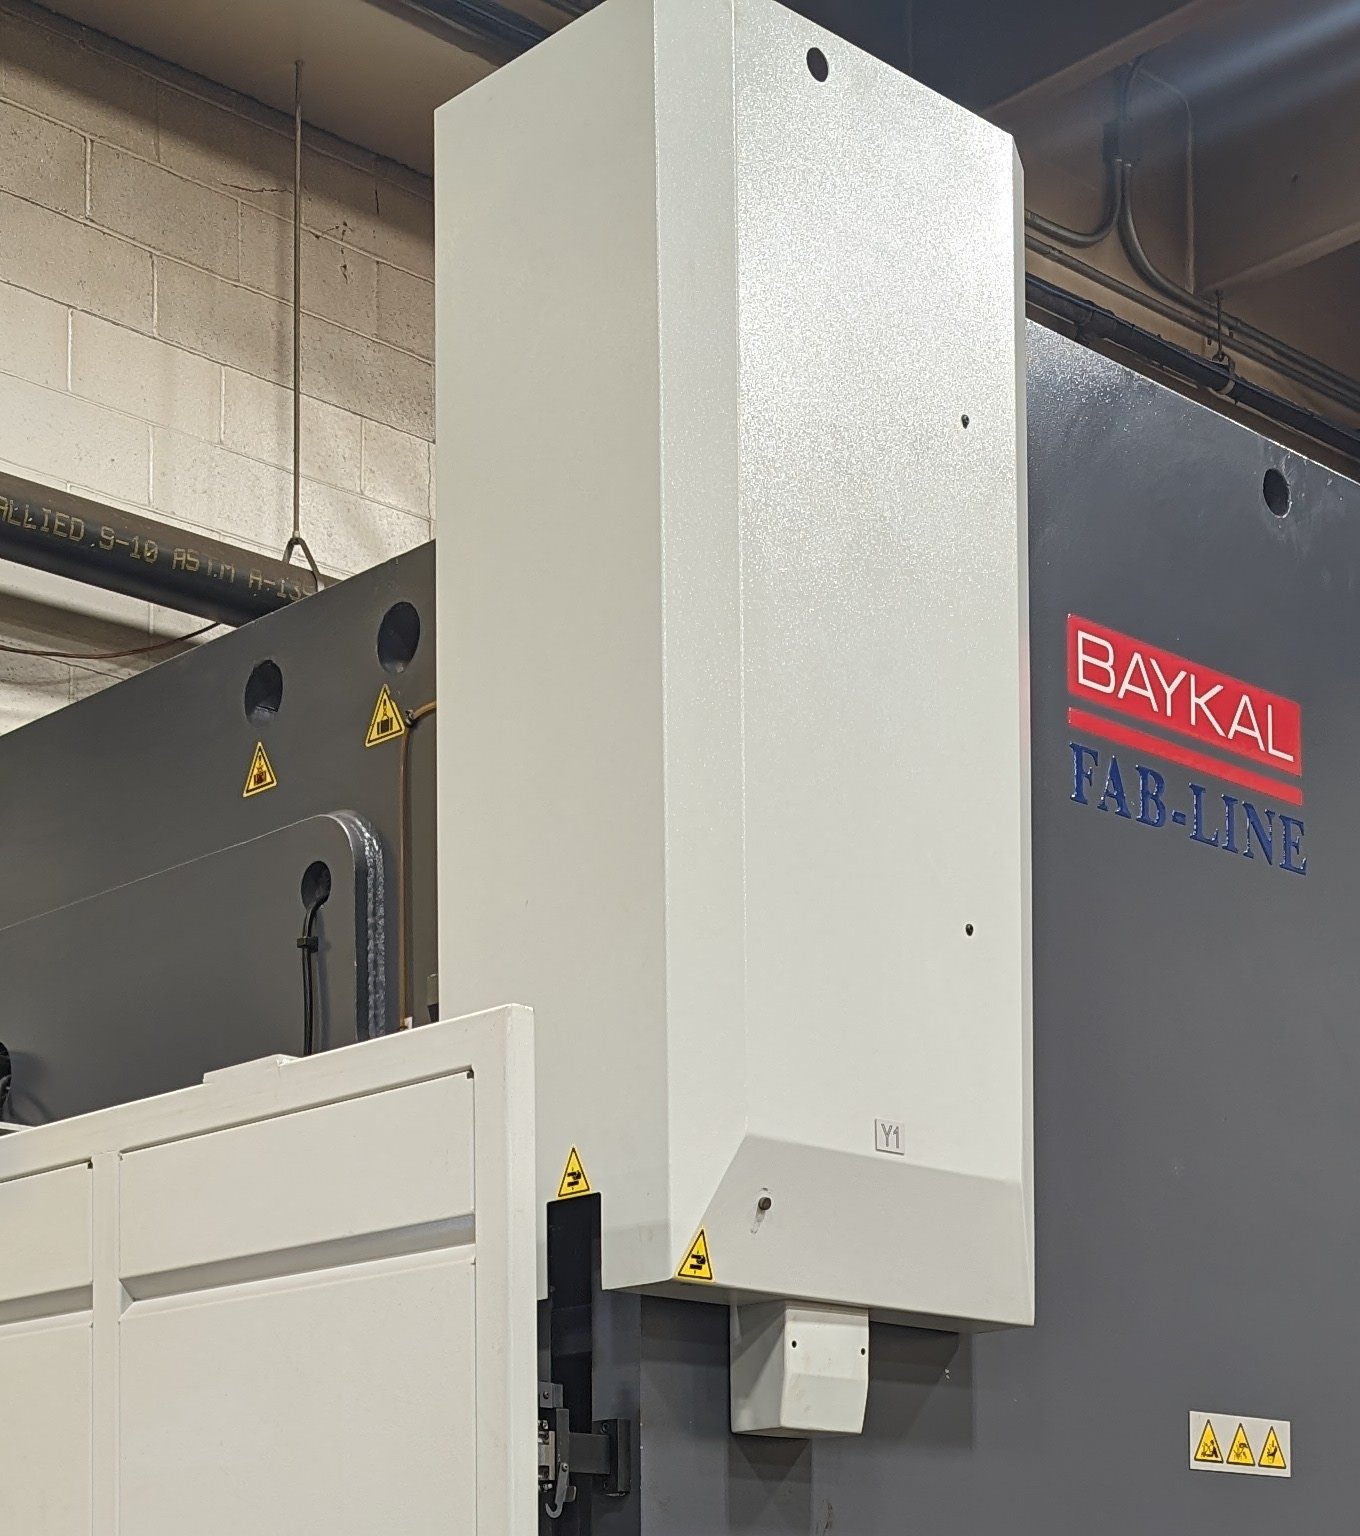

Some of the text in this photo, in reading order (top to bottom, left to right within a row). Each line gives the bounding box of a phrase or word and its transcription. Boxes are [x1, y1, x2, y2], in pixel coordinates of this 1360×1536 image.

[1076, 629, 1295, 763] BAYKAL
[1069, 742, 1308, 876] FAB-LINE
[880, 1122, 900, 1149] Y1
